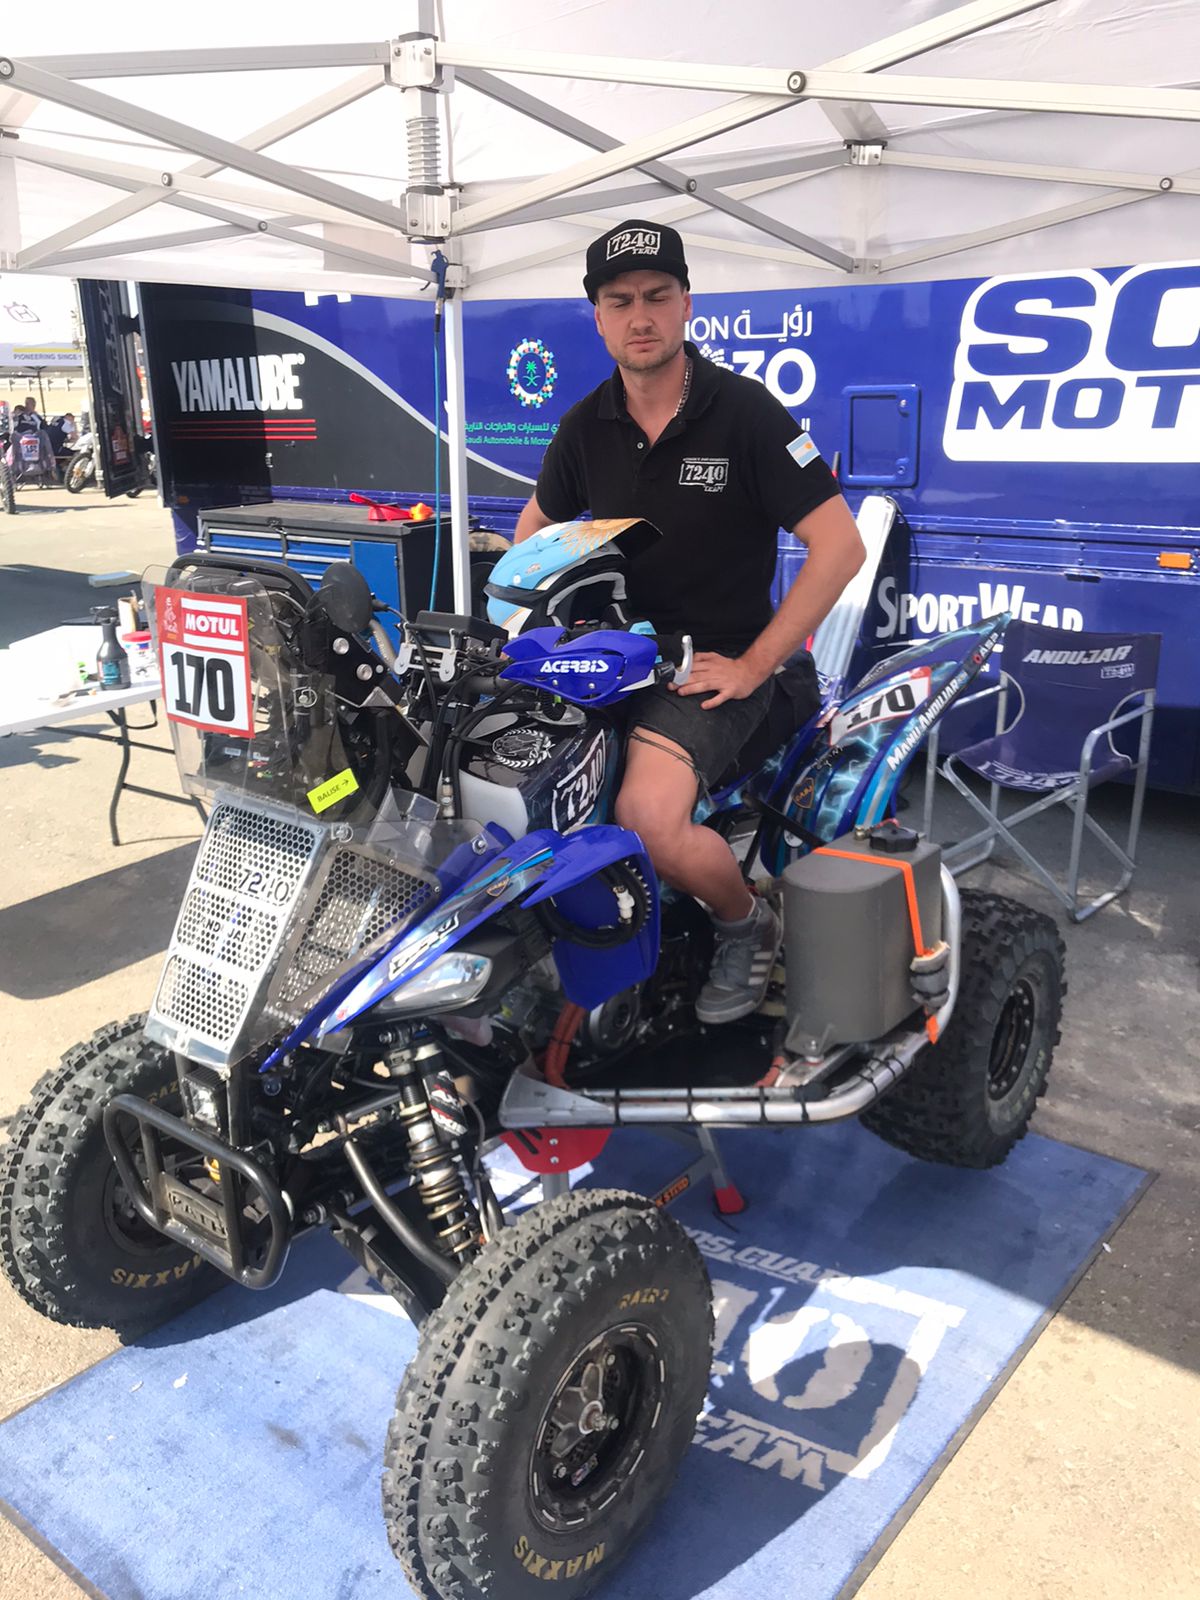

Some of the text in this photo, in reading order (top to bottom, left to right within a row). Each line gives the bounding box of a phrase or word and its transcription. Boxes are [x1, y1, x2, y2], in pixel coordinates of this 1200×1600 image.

[612, 232, 656, 252] 7240
[632, 248, 658, 256] TEAM
[684, 315, 729, 342] ION
[733, 303, 813, 343] رؤية
[171, 353, 303, 412] YAMALUBE
[483, 436, 523, 445] Automobile
[685, 464, 725, 484] 7240
[185, 613, 240, 636] MOTUL
[1022, 645, 1133, 665] ANDUJAR
[170, 651, 236, 722] 170
[316, 784, 340, 802] BALISE
[561, 749, 603, 820] 7240
[513, 1535, 605, 1580] MAXXIS
